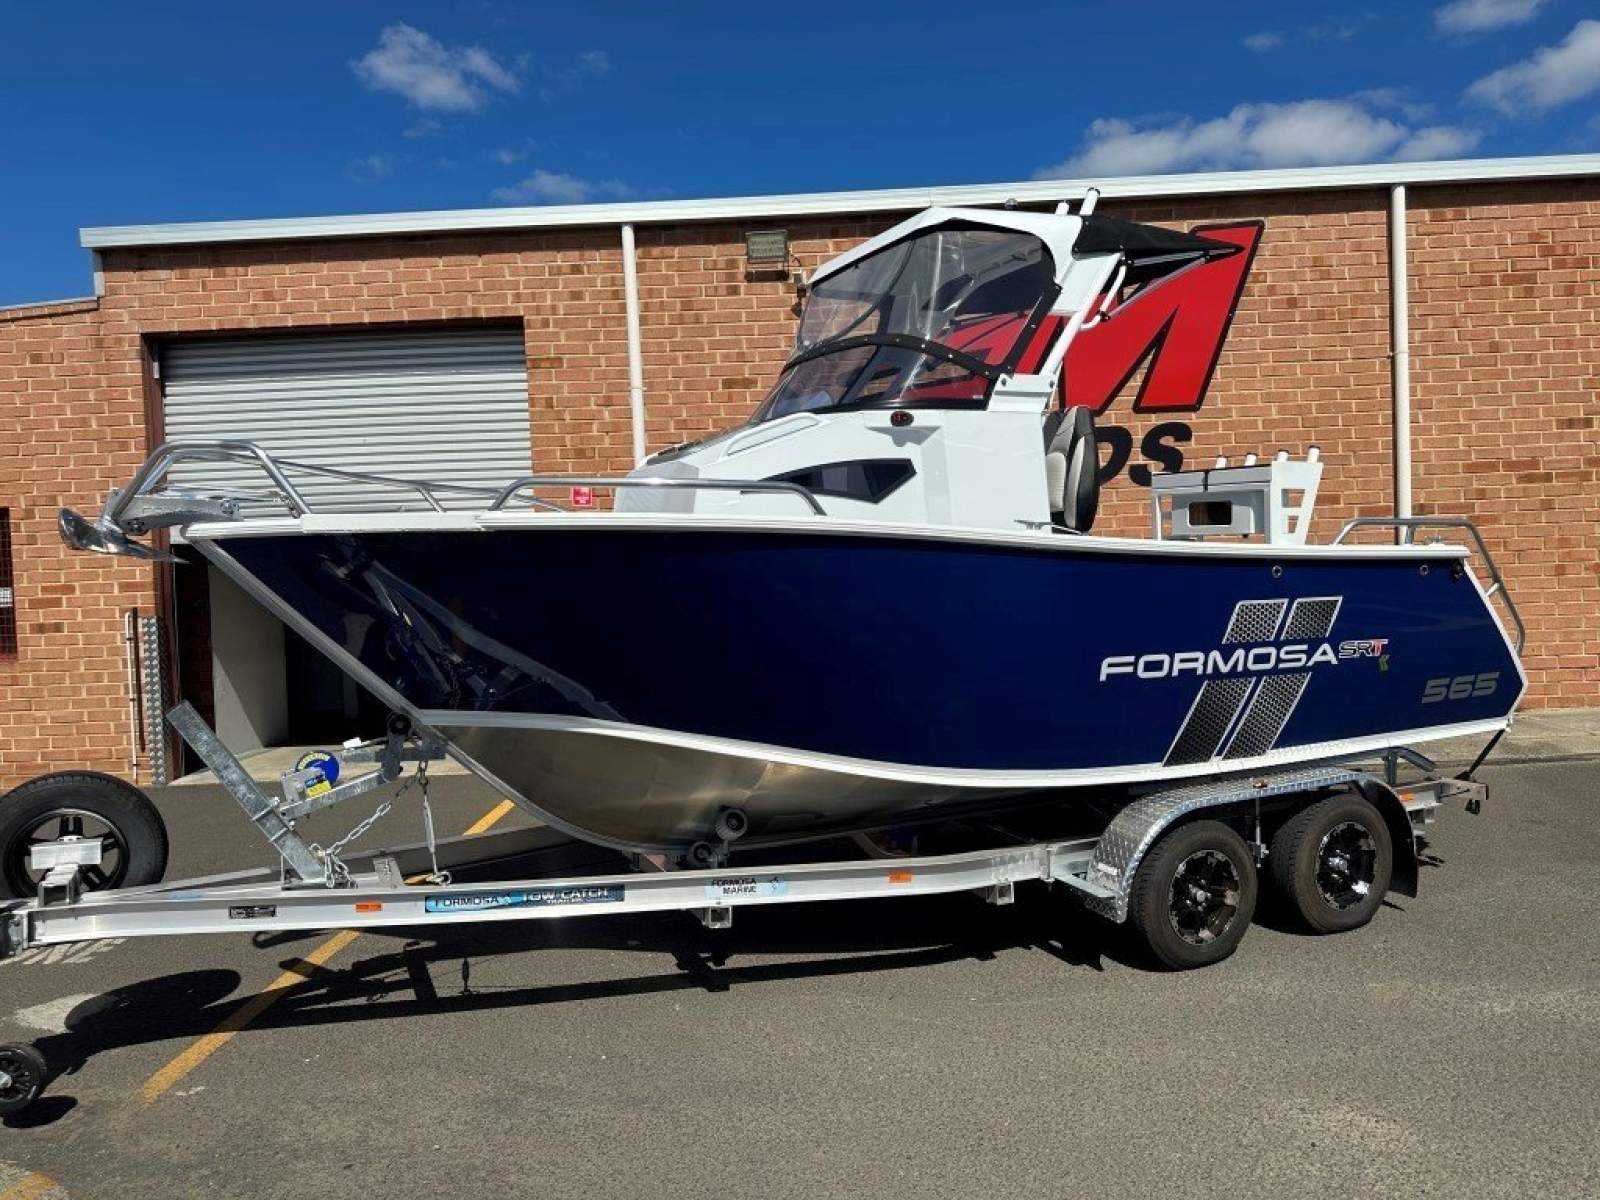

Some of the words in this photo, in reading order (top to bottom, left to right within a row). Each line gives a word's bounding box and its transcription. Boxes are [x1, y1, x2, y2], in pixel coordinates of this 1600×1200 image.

[1099, 643, 1338, 682] FORMOSA
[1338, 638, 1389, 659] SRT
[1421, 671, 1500, 704] 565
[435, 895, 499, 908] FORMOSA
